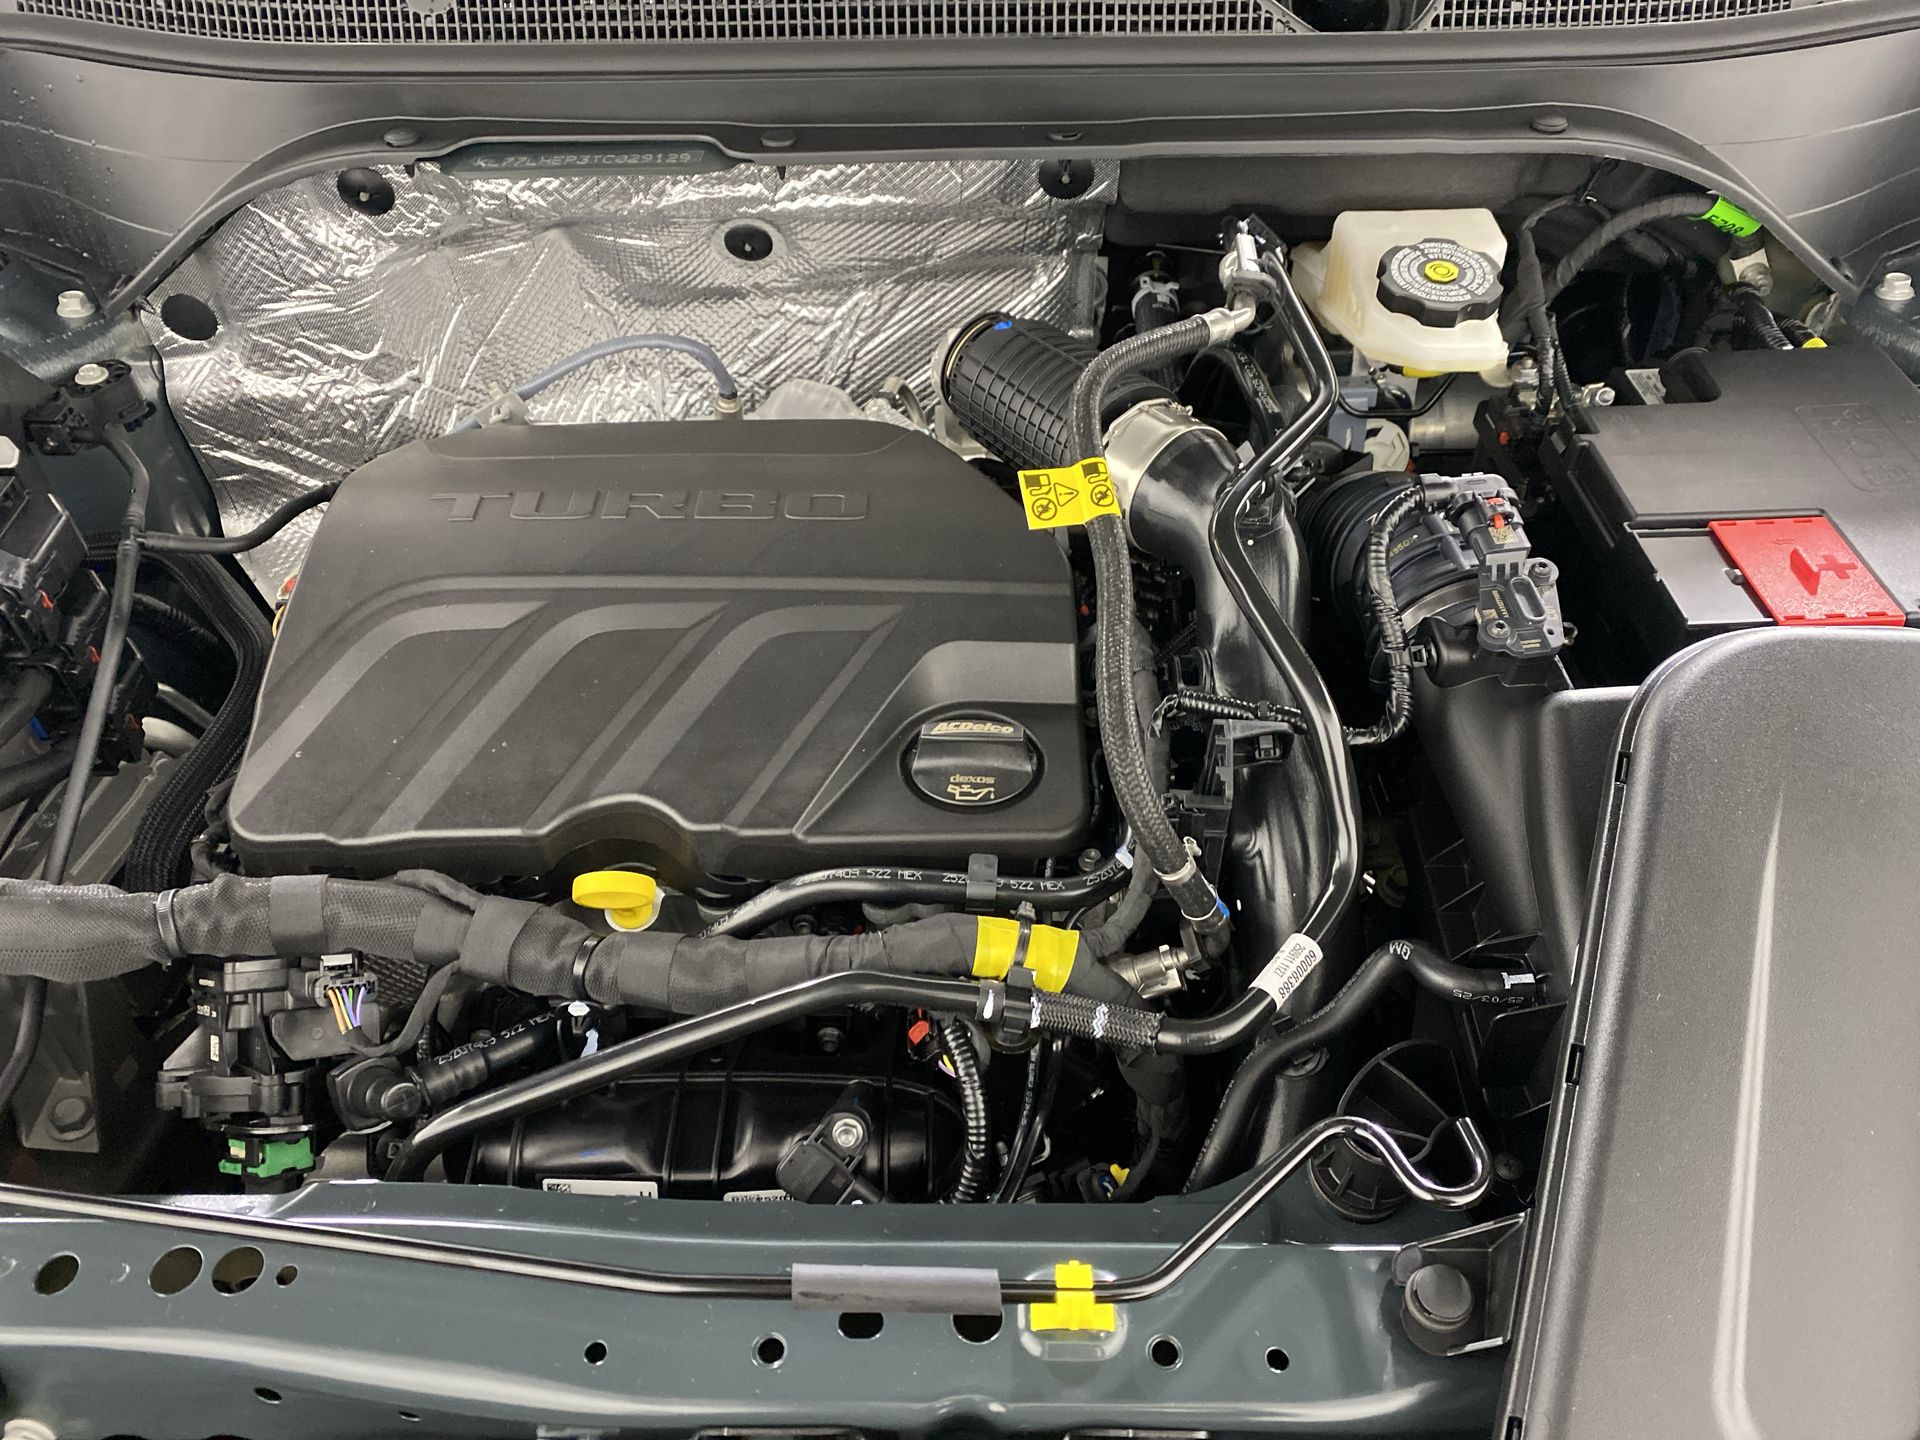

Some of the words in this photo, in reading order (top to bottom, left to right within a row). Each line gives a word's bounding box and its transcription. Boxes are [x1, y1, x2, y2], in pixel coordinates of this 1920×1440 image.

[472, 151, 692, 168] KL77LHEP3TC029129
[427, 490, 871, 523] TURBO
[931, 721, 1015, 734] ACDelco
[949, 773, 996, 784] dexos
[866, 868, 892, 879] 522
[898, 870, 923, 881] MEX
[1010, 880, 1035, 891] 522
[1040, 880, 1067, 891] MEX
[1389, 941, 1411, 960] GM
[1452, 988, 1524, 1003] 25/03/25
